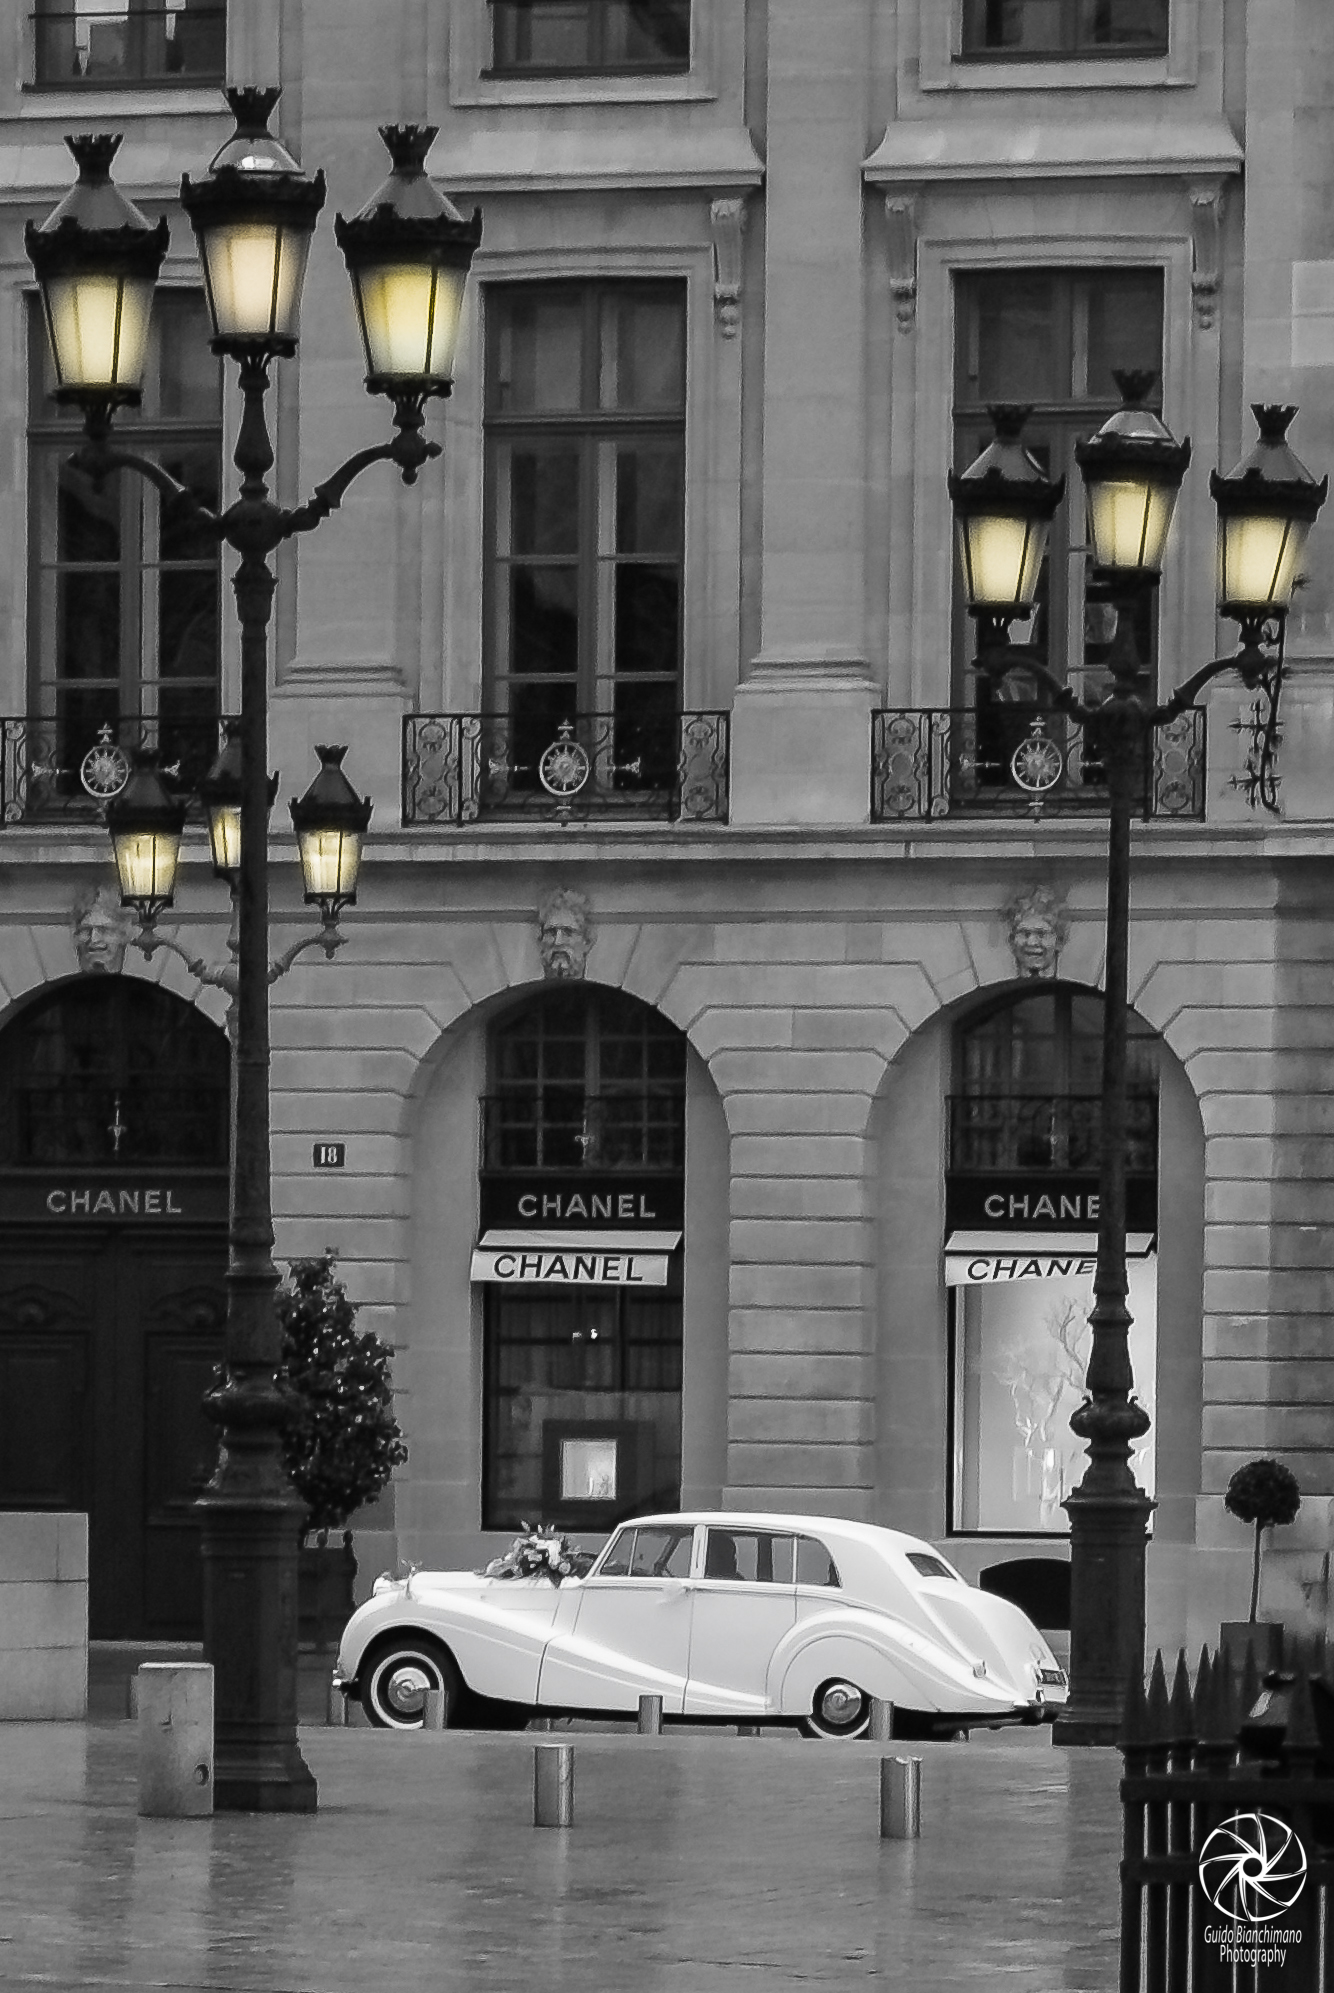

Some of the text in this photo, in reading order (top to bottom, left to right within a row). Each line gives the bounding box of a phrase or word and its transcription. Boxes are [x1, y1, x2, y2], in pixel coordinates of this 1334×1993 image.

[320, 1145, 338, 1165] 18
[46, 1189, 182, 1214] CHANEL
[517, 1193, 656, 1218] CHANEL
[983, 1194, 1100, 1219] CHANE
[493, 1254, 643, 1281] CHANEL
[966, 1258, 1097, 1281] CHANE
